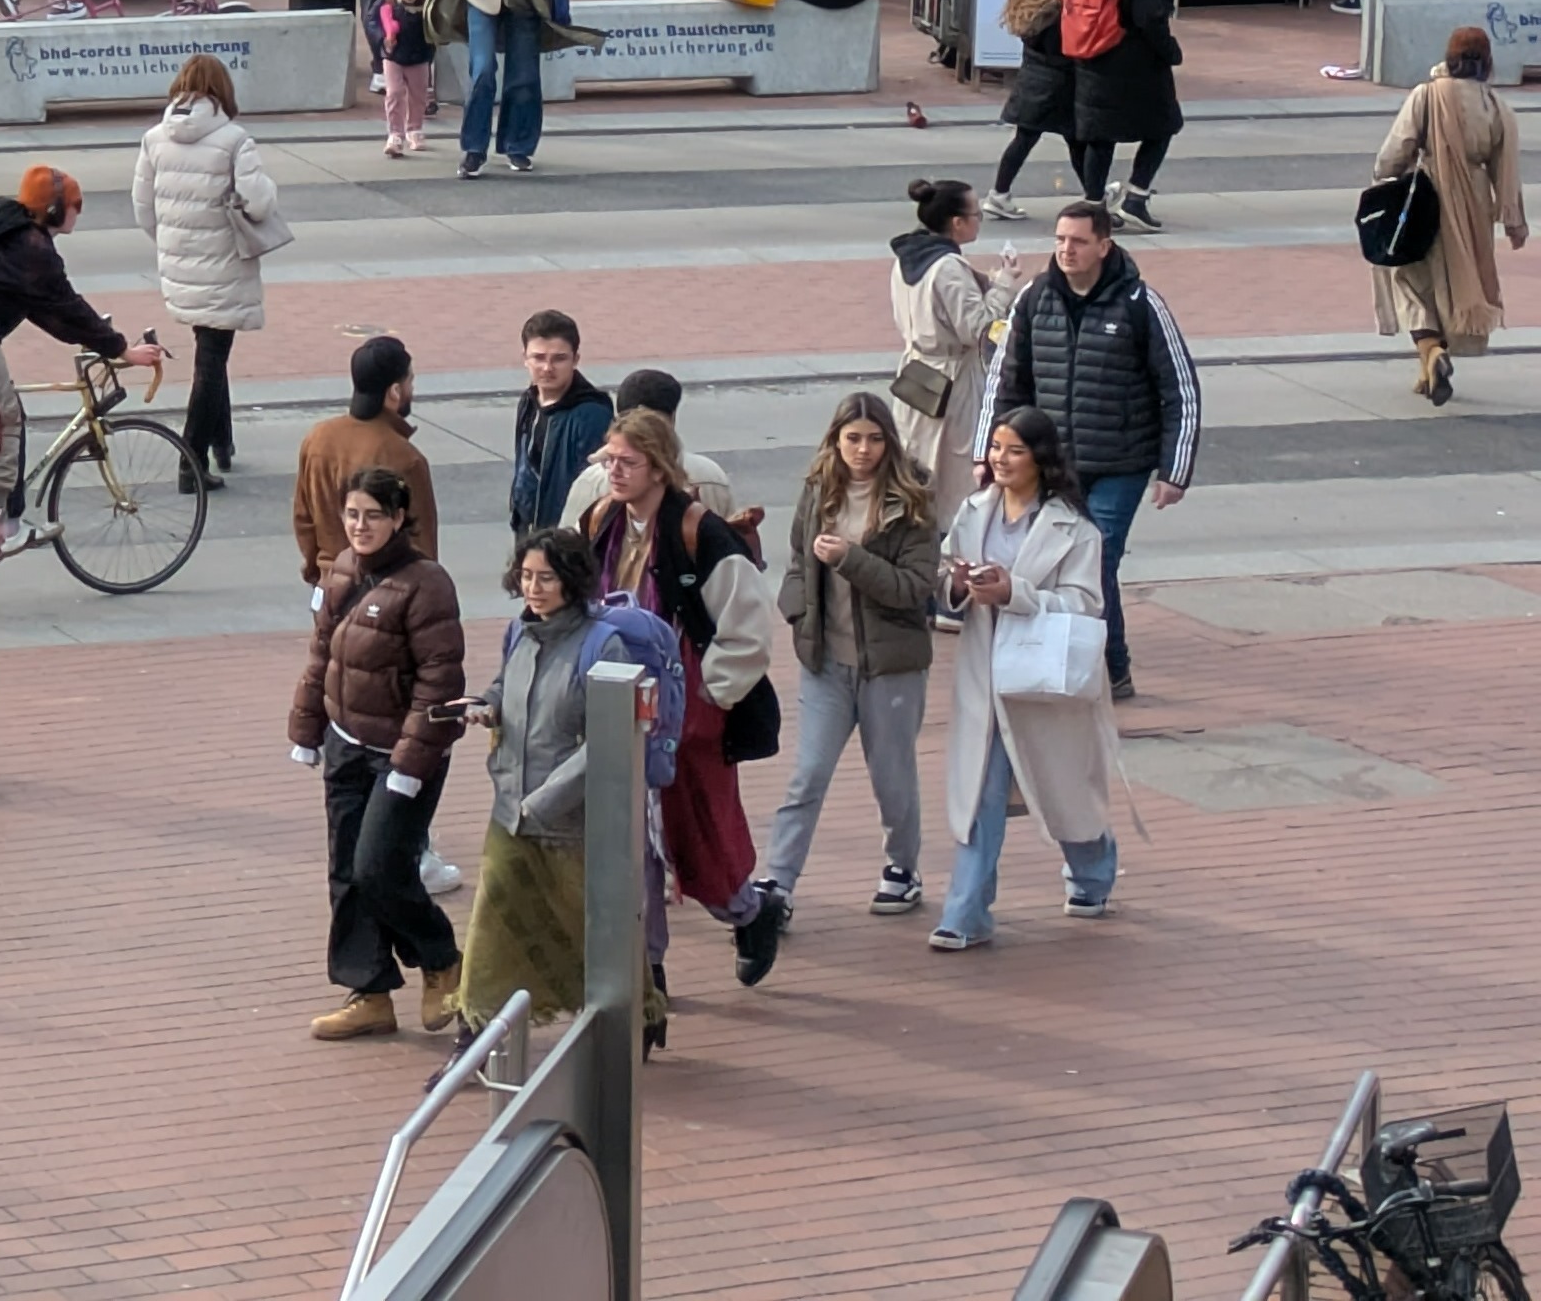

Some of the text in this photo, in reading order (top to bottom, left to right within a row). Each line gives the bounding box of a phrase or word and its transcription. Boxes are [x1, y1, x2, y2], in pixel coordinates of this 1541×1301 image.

[666, 22, 776, 37] Bausicherung
[39, 40, 251, 60] bhd-cordts Bausicherung
